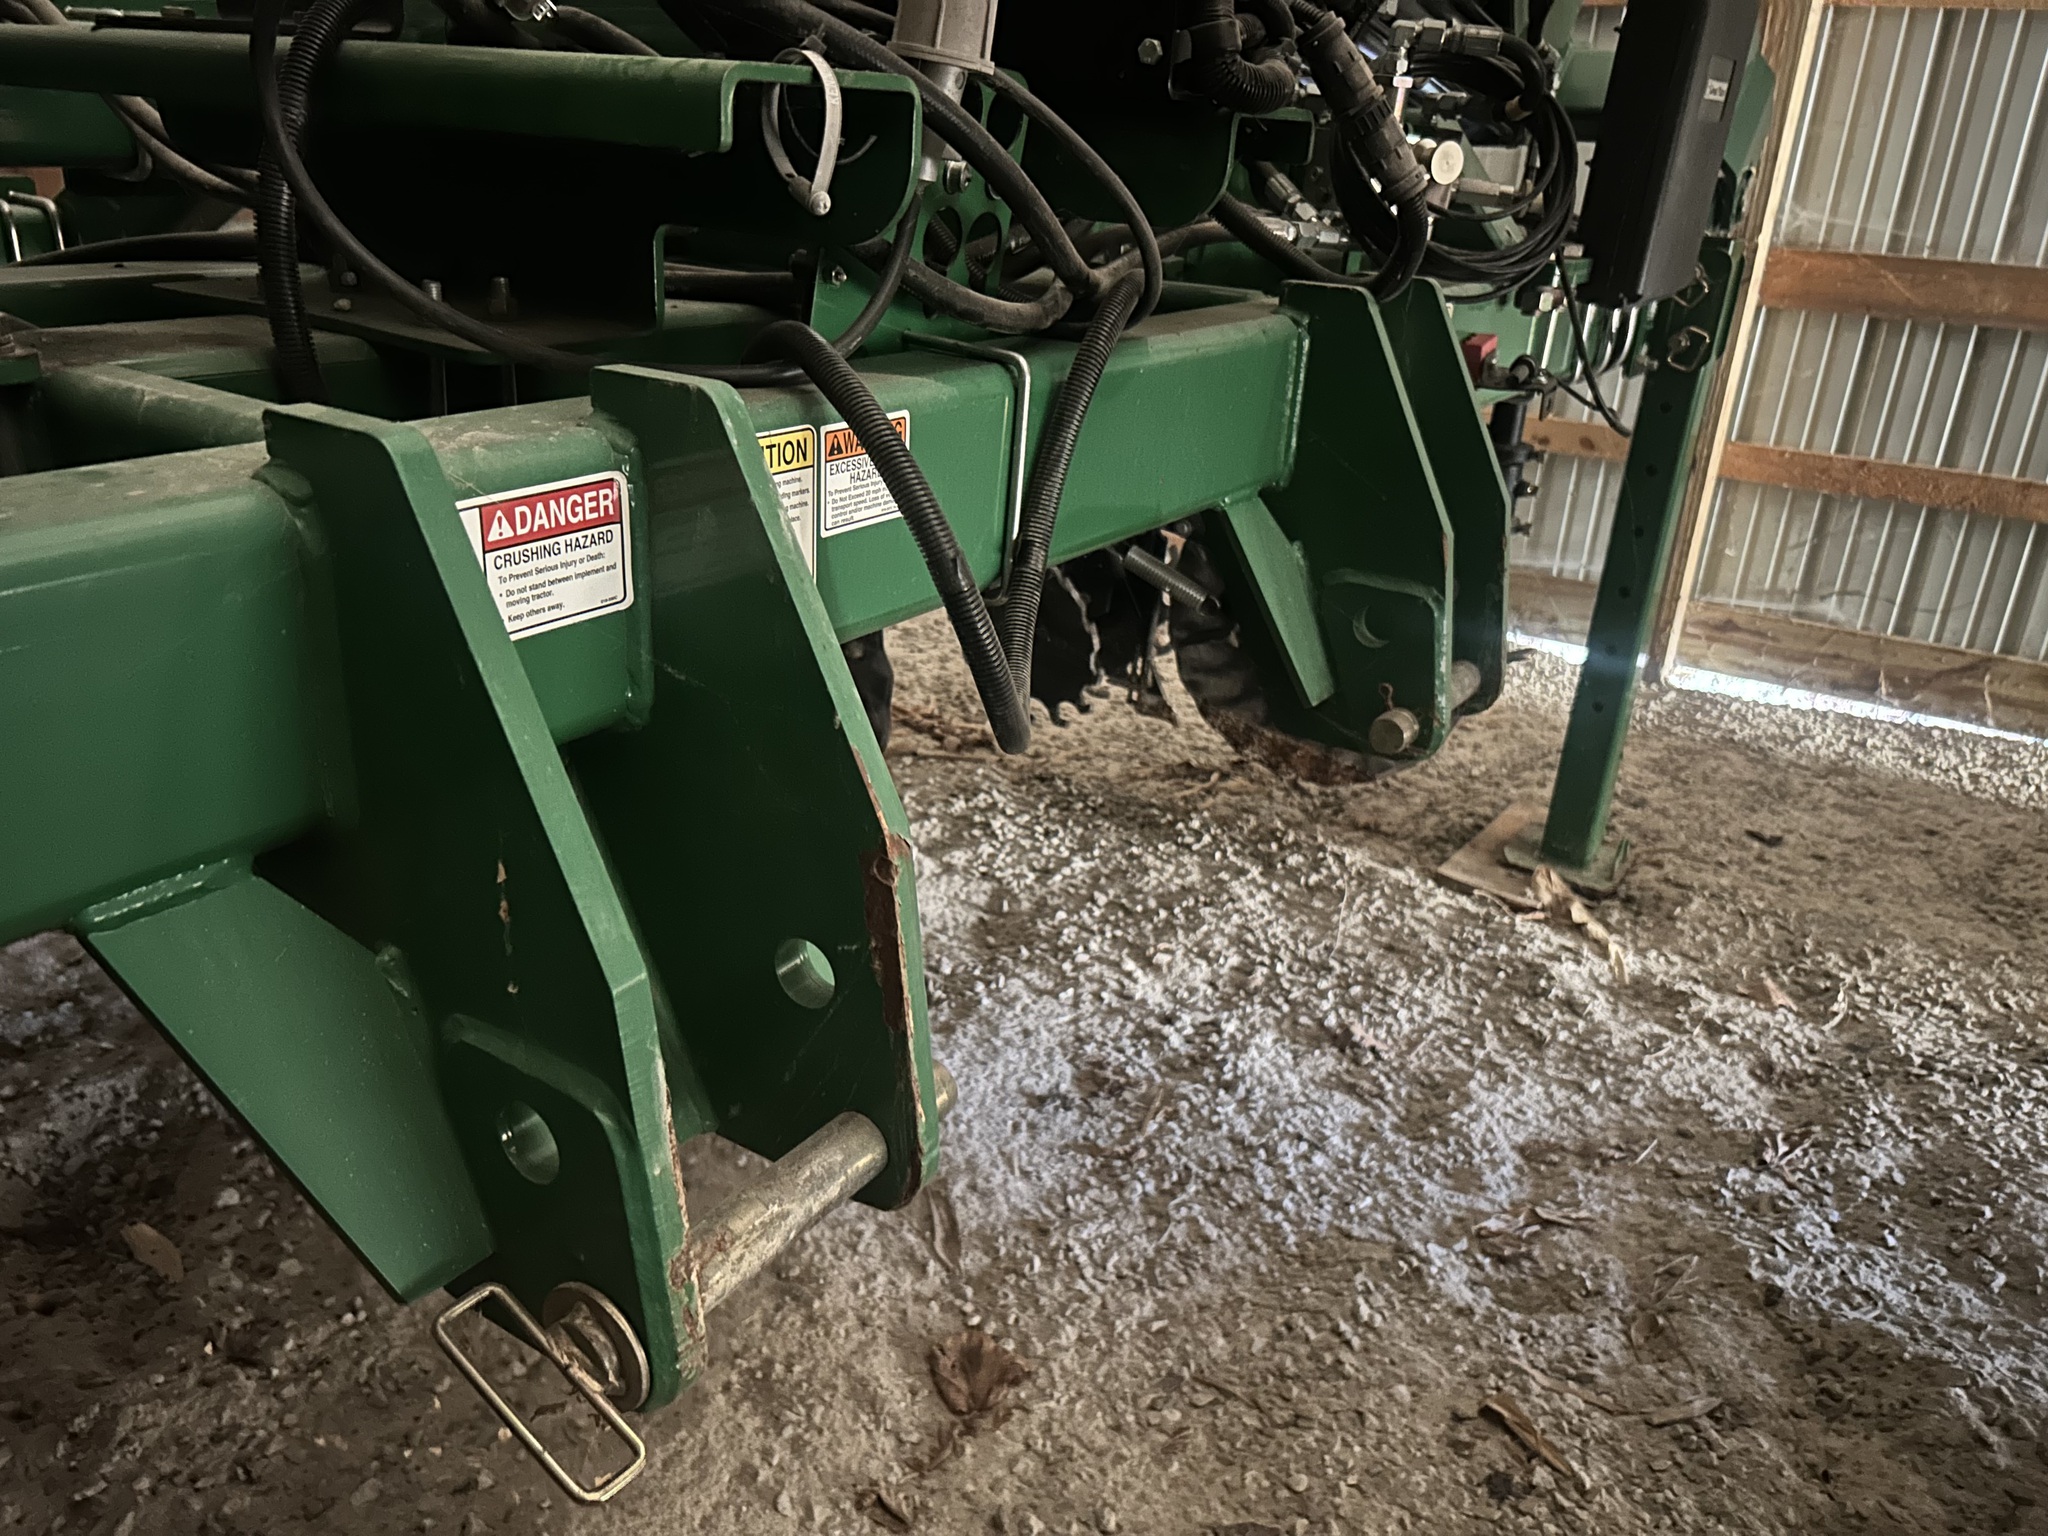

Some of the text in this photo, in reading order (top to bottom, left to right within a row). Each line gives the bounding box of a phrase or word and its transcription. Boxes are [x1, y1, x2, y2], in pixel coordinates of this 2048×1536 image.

[762, 437, 807, 468] TION
[850, 467, 880, 485] HAZAR
[834, 486, 851, 495] Prevent
[853, 481, 869, 491] Serious
[848, 491, 865, 501] Exceed
[515, 488, 614, 536] DANGER
[831, 501, 853, 512] transport
[831, 510, 848, 519] control
[493, 529, 614, 570] CRUSHING HAZARD
[498, 575, 508, 585] To
[508, 569, 534, 582] Prevent
[535, 564, 559, 575] Serious
[560, 559, 577, 570] Injury
[505, 562, 617, 598] Do not stand between implement and
[506, 589, 554, 608] moving tractor.
[508, 601, 565, 623] Keep others away.
